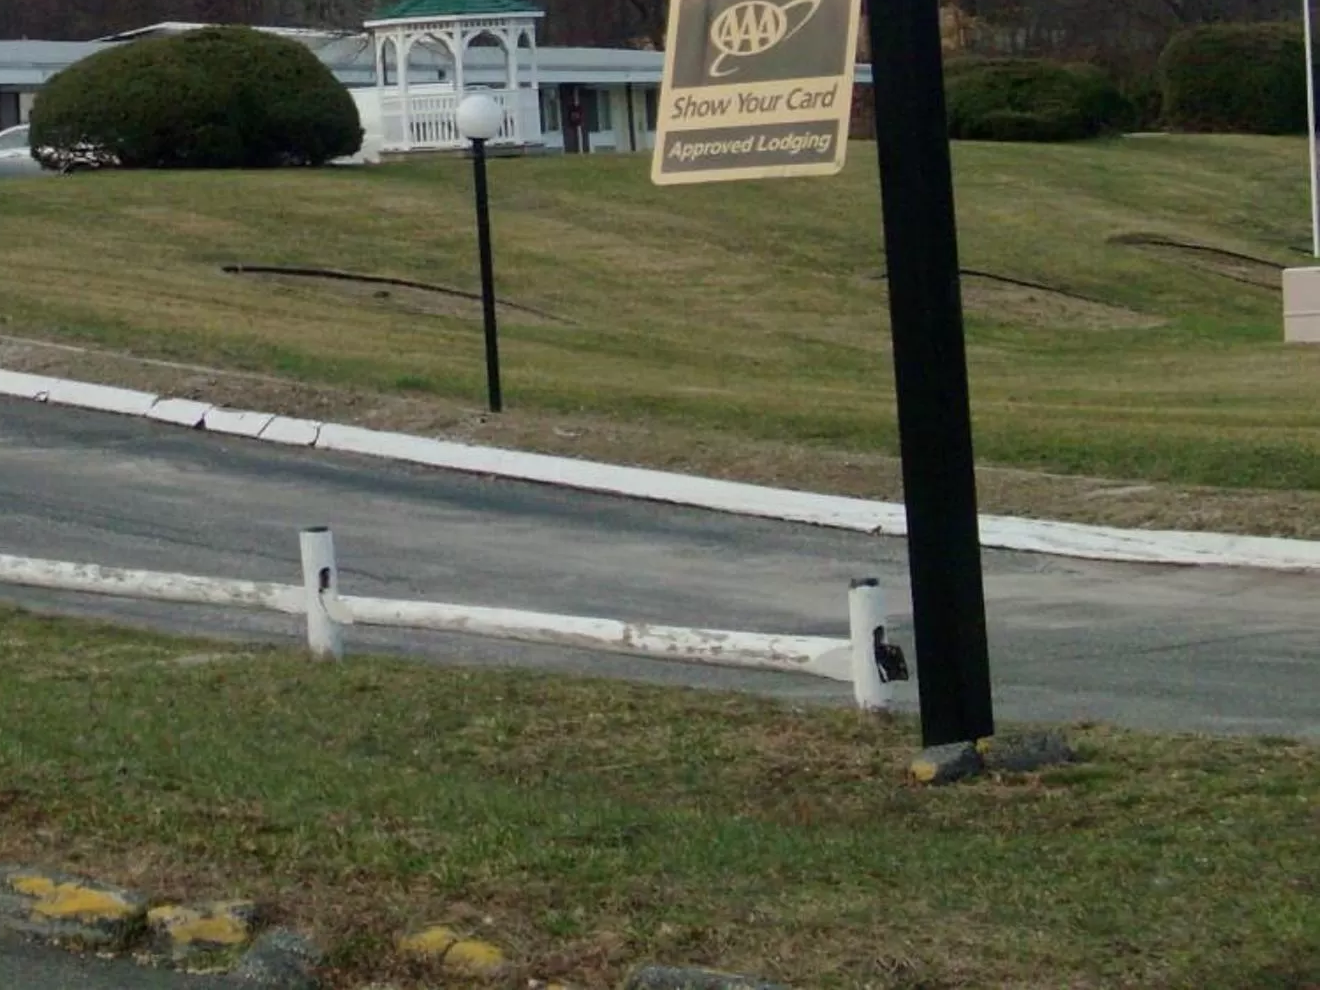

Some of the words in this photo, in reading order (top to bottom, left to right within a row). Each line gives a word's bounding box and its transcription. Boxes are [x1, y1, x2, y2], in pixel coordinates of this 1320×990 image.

[720, 3, 781, 53] AAA
[671, 94, 730, 119] Show
[737, 92, 783, 113] Your
[786, 83, 838, 110] Card
[668, 136, 754, 161] Approved
[758, 132, 832, 154] Lodging
